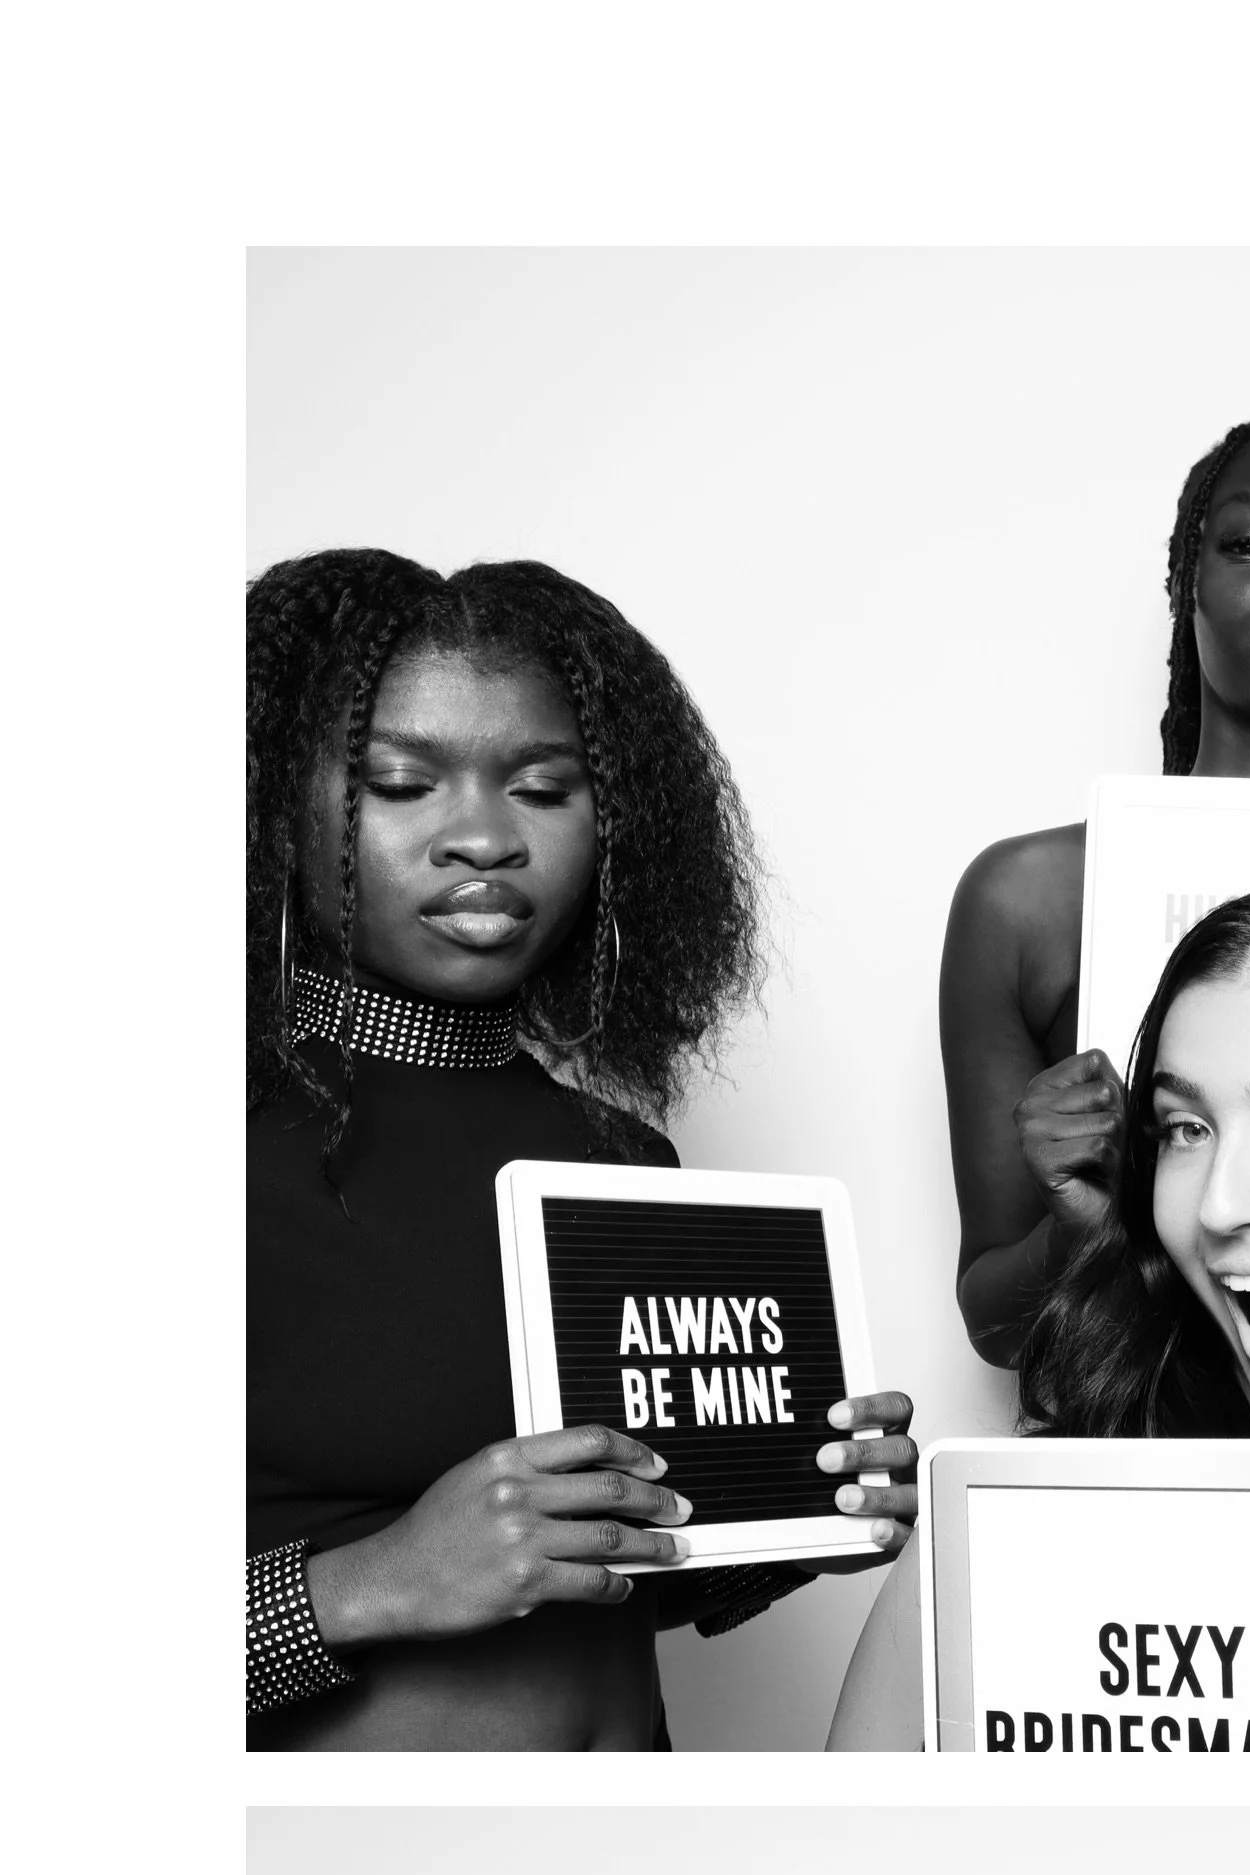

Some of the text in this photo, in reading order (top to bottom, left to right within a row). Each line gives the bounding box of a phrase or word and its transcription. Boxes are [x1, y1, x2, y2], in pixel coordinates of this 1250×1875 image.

[619, 1296, 784, 1355] ALWAYS
[621, 1366, 795, 1429] BE MINE
[1099, 1621, 1246, 1699] SEXY
